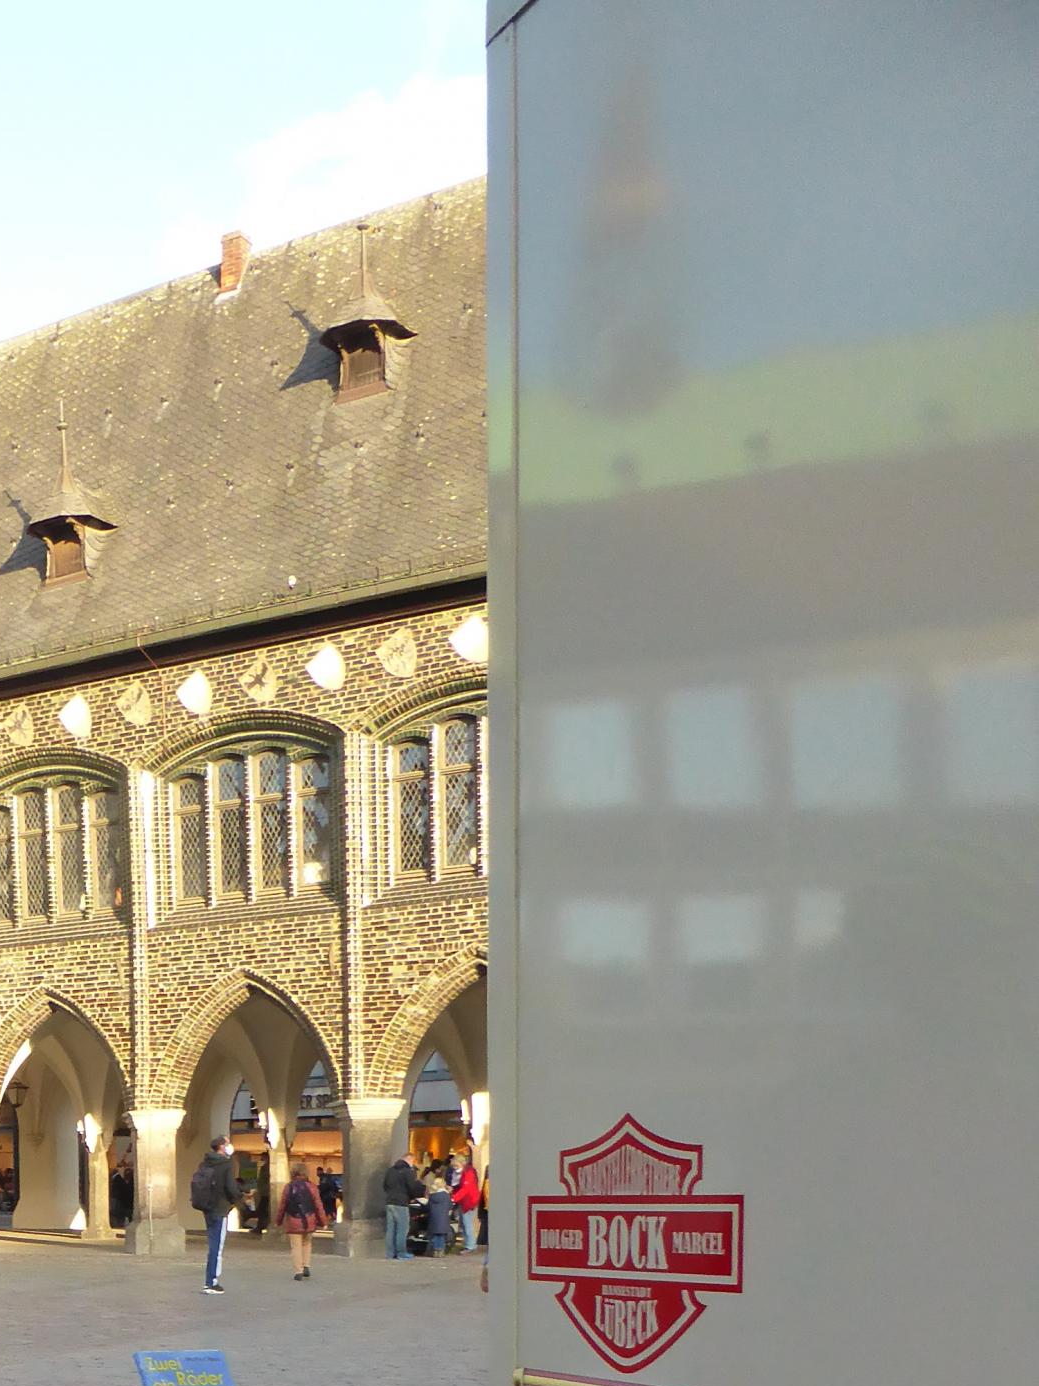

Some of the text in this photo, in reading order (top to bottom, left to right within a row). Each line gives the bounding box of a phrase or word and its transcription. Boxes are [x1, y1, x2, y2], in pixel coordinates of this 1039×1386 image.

[540, 1215, 725, 1270] HOLGER BOCK MARCEL
[594, 1295, 659, 1349] LÜBECK
[145, 1357, 180, 1371] Zwei
[176, 1369, 224, 1386] Räder
